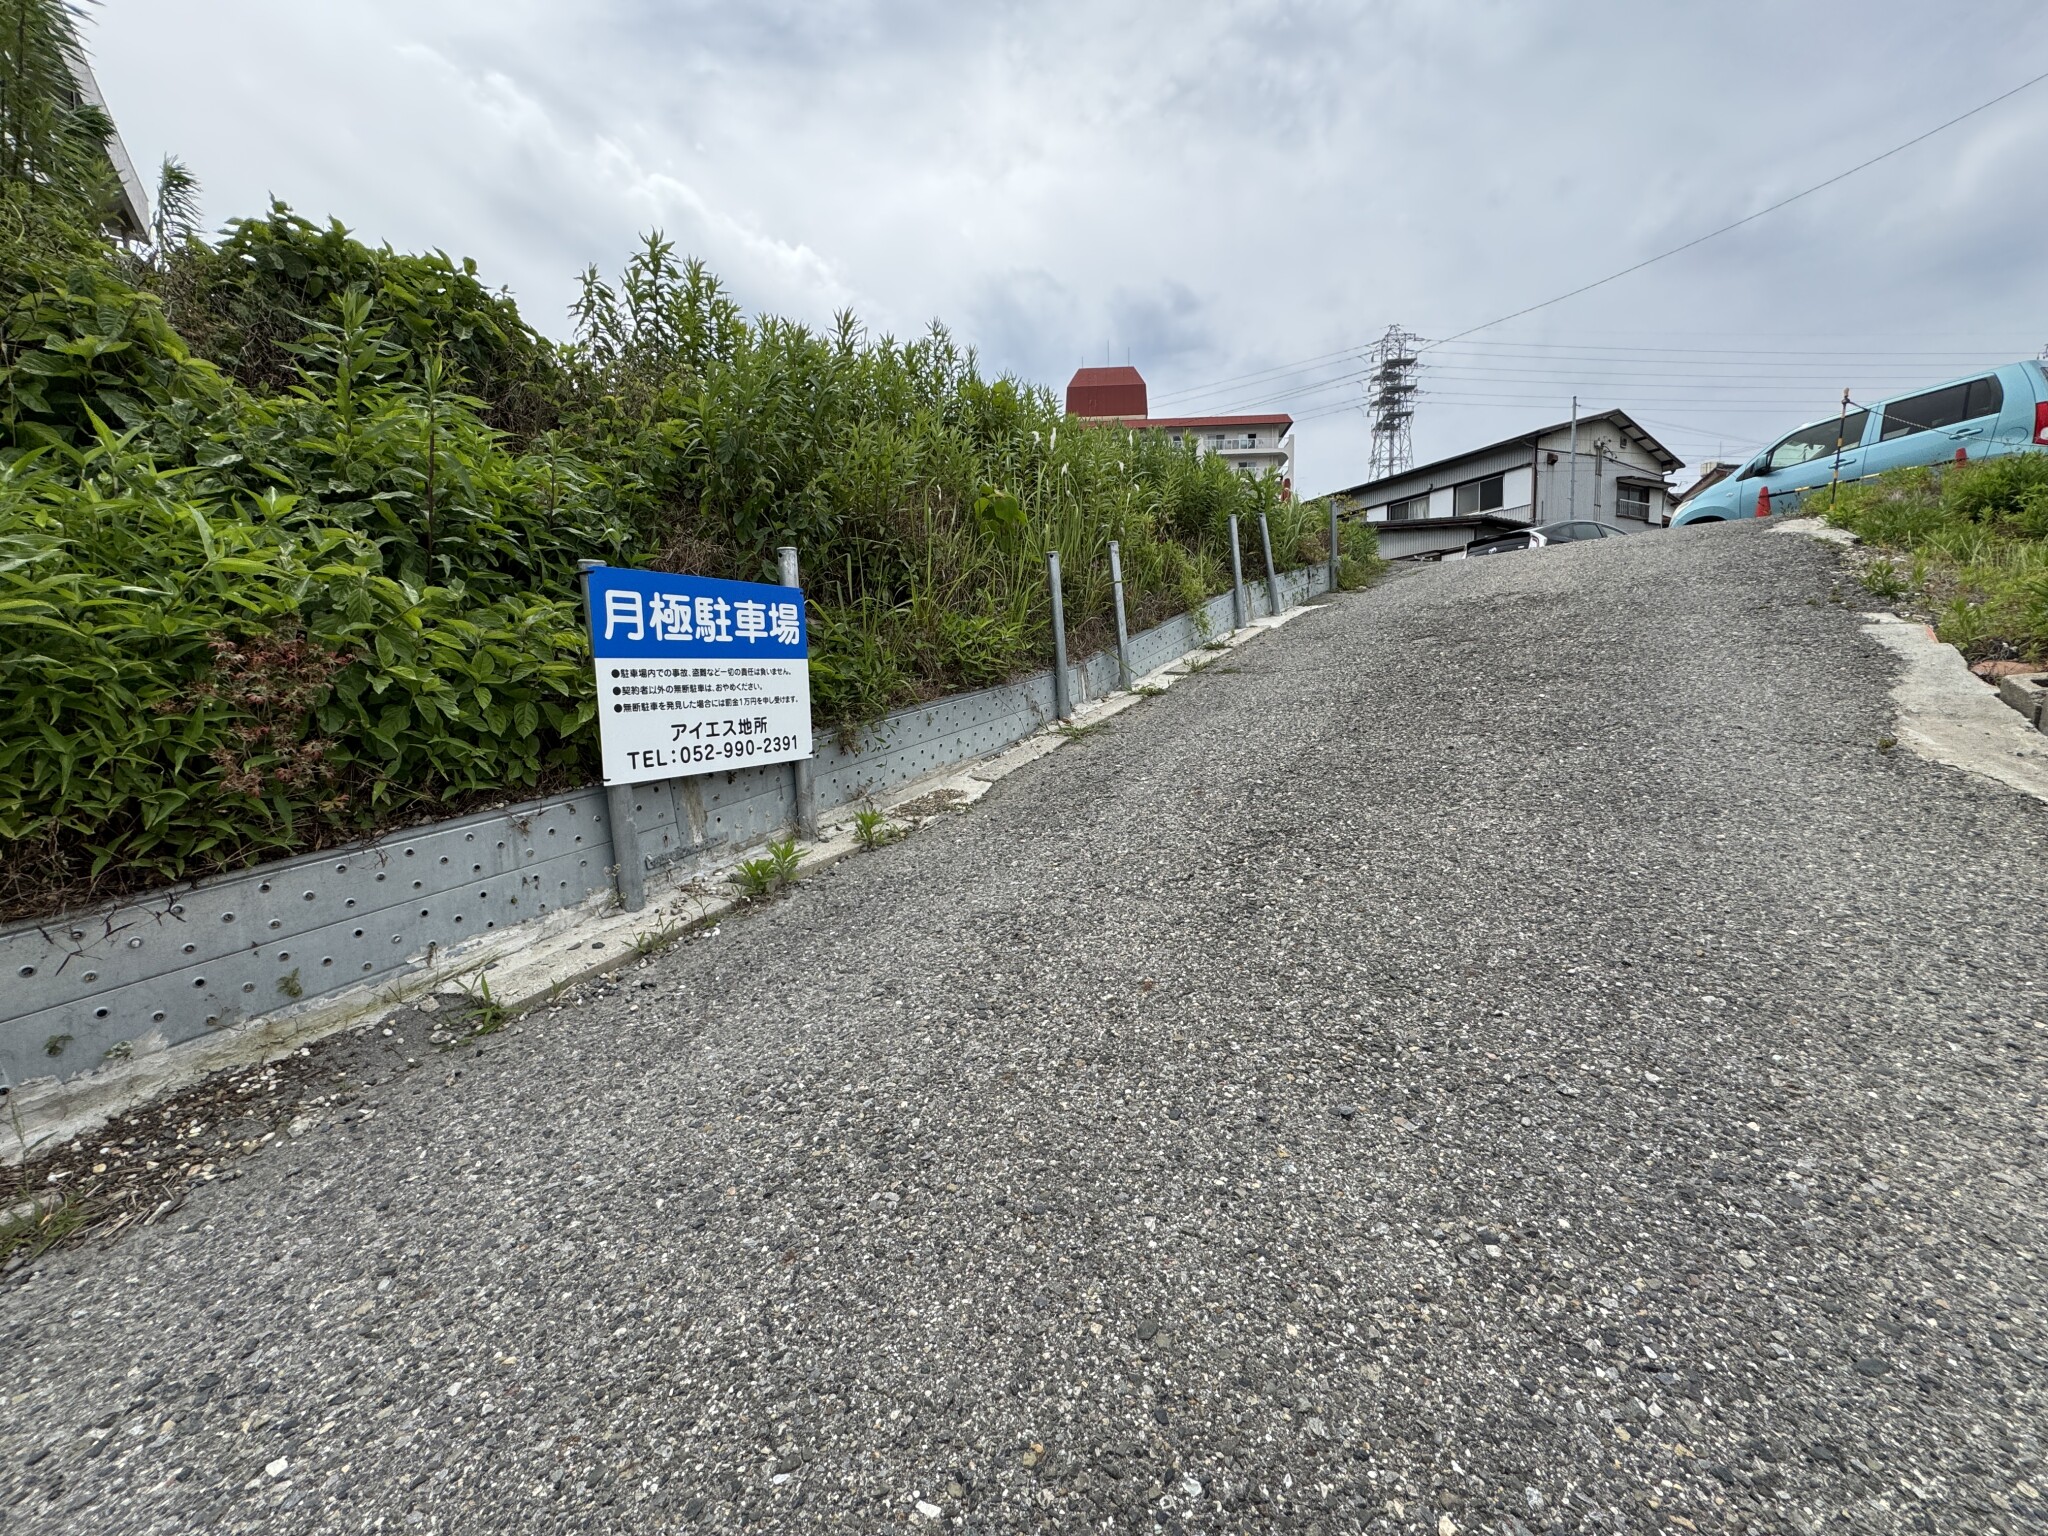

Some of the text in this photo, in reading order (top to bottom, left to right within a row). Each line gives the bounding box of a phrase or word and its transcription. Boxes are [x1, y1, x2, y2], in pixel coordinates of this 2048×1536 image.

[605, 590, 800, 645] 月極駐車場
[671, 717, 768, 742] アイエス地所
[627, 735, 798, 770] TEL:052-990-2391
